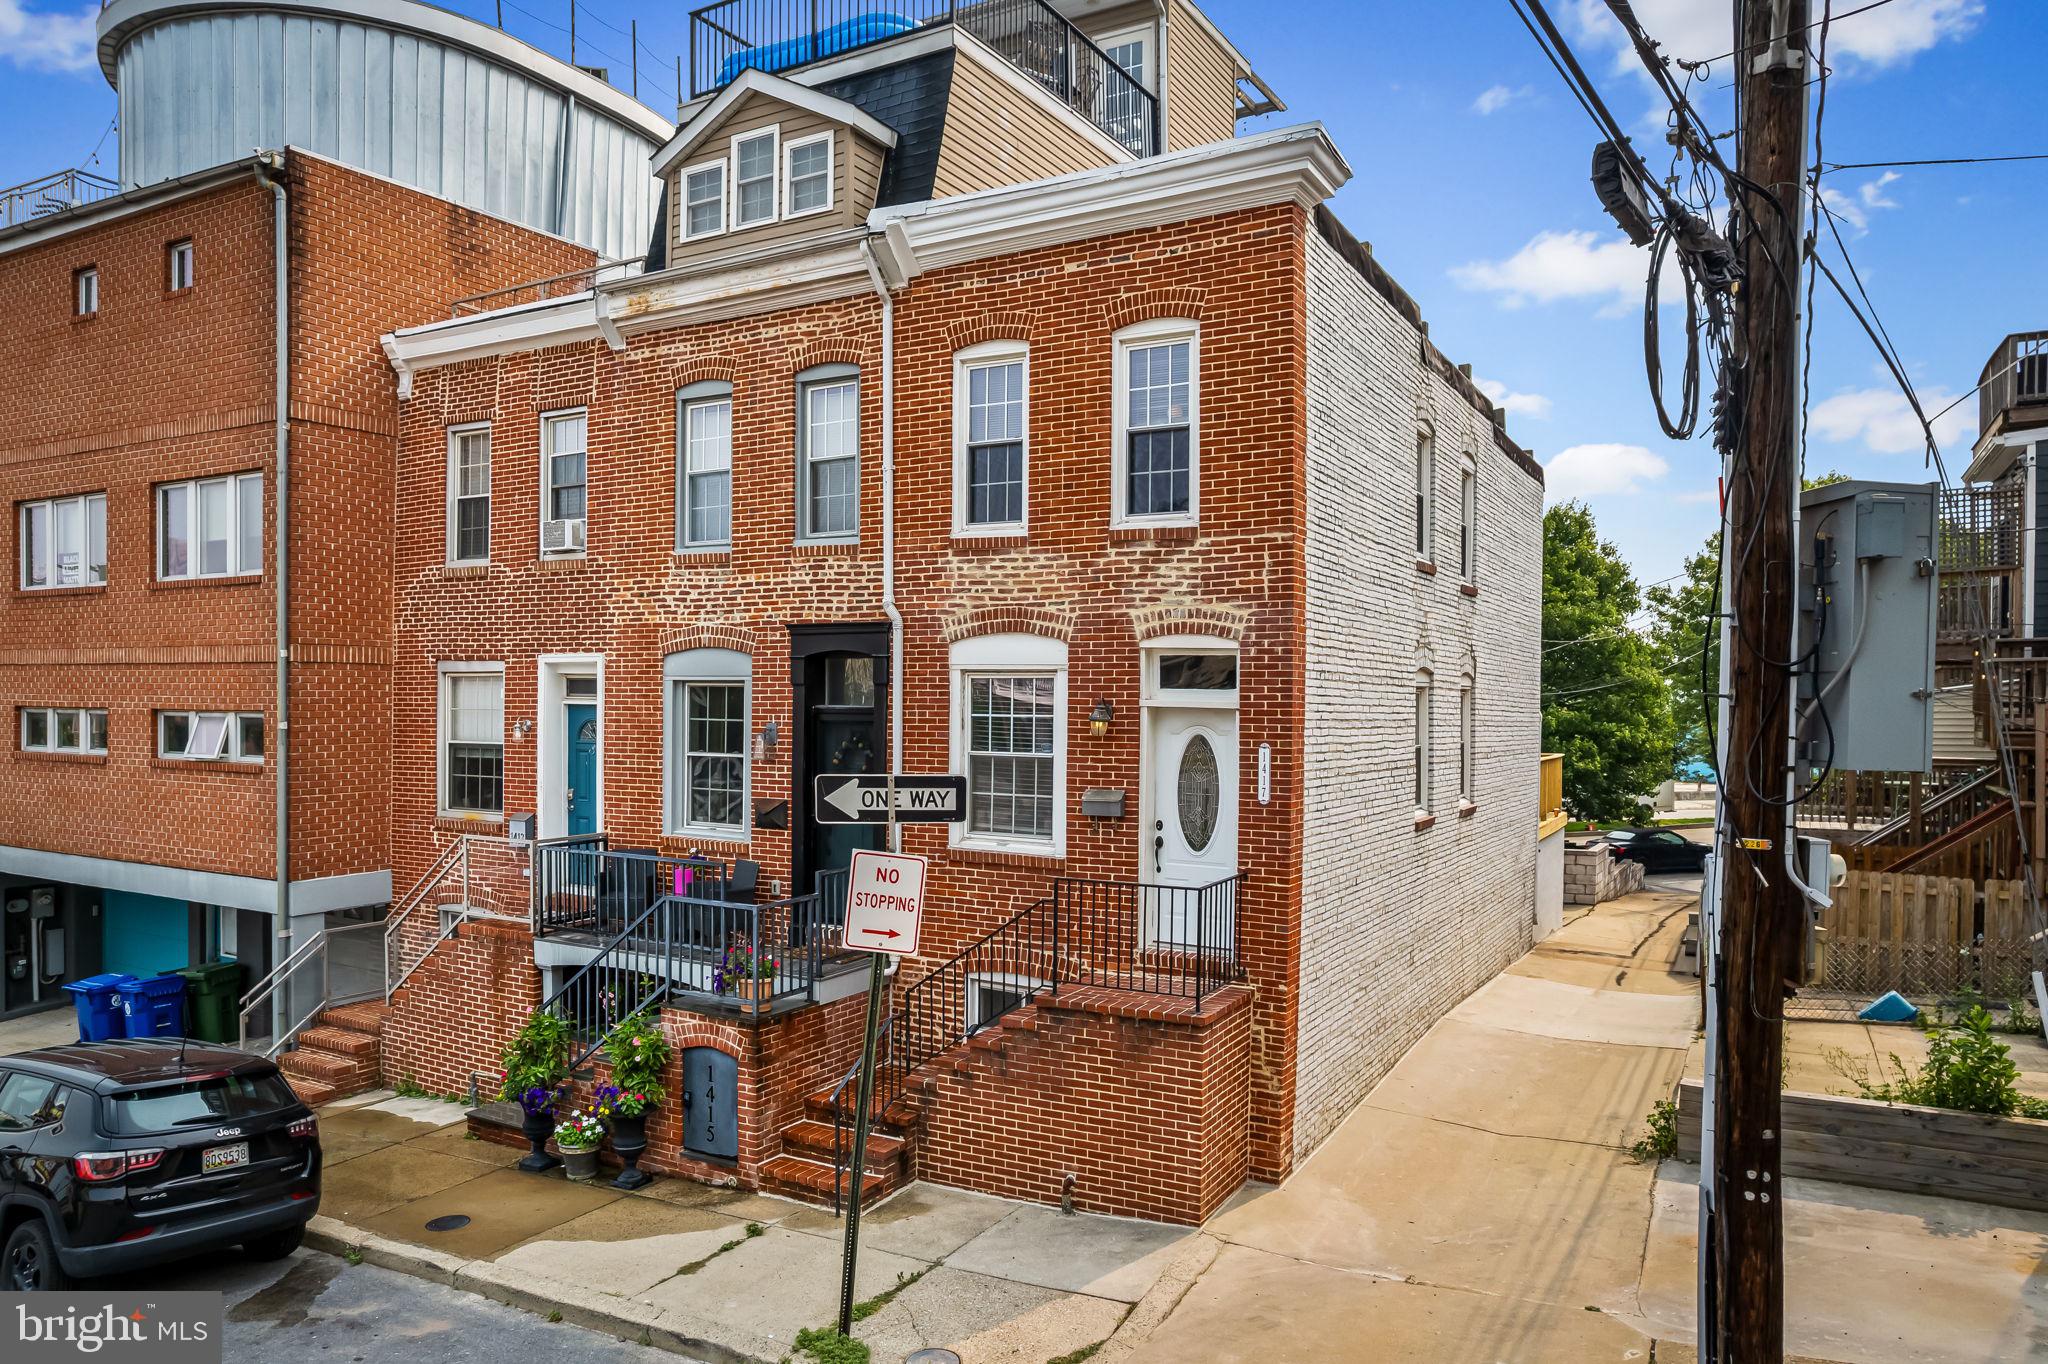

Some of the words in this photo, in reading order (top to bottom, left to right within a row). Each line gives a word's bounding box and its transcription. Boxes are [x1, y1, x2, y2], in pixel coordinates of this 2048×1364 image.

[861, 790, 902, 808] ONE
[909, 790, 951, 808] WAY
[876, 867, 900, 884] NO
[855, 892, 915, 913] STOPPING
[705, 1065, 715, 1142] 1415
[216, 1127, 241, 1137] Jeep
